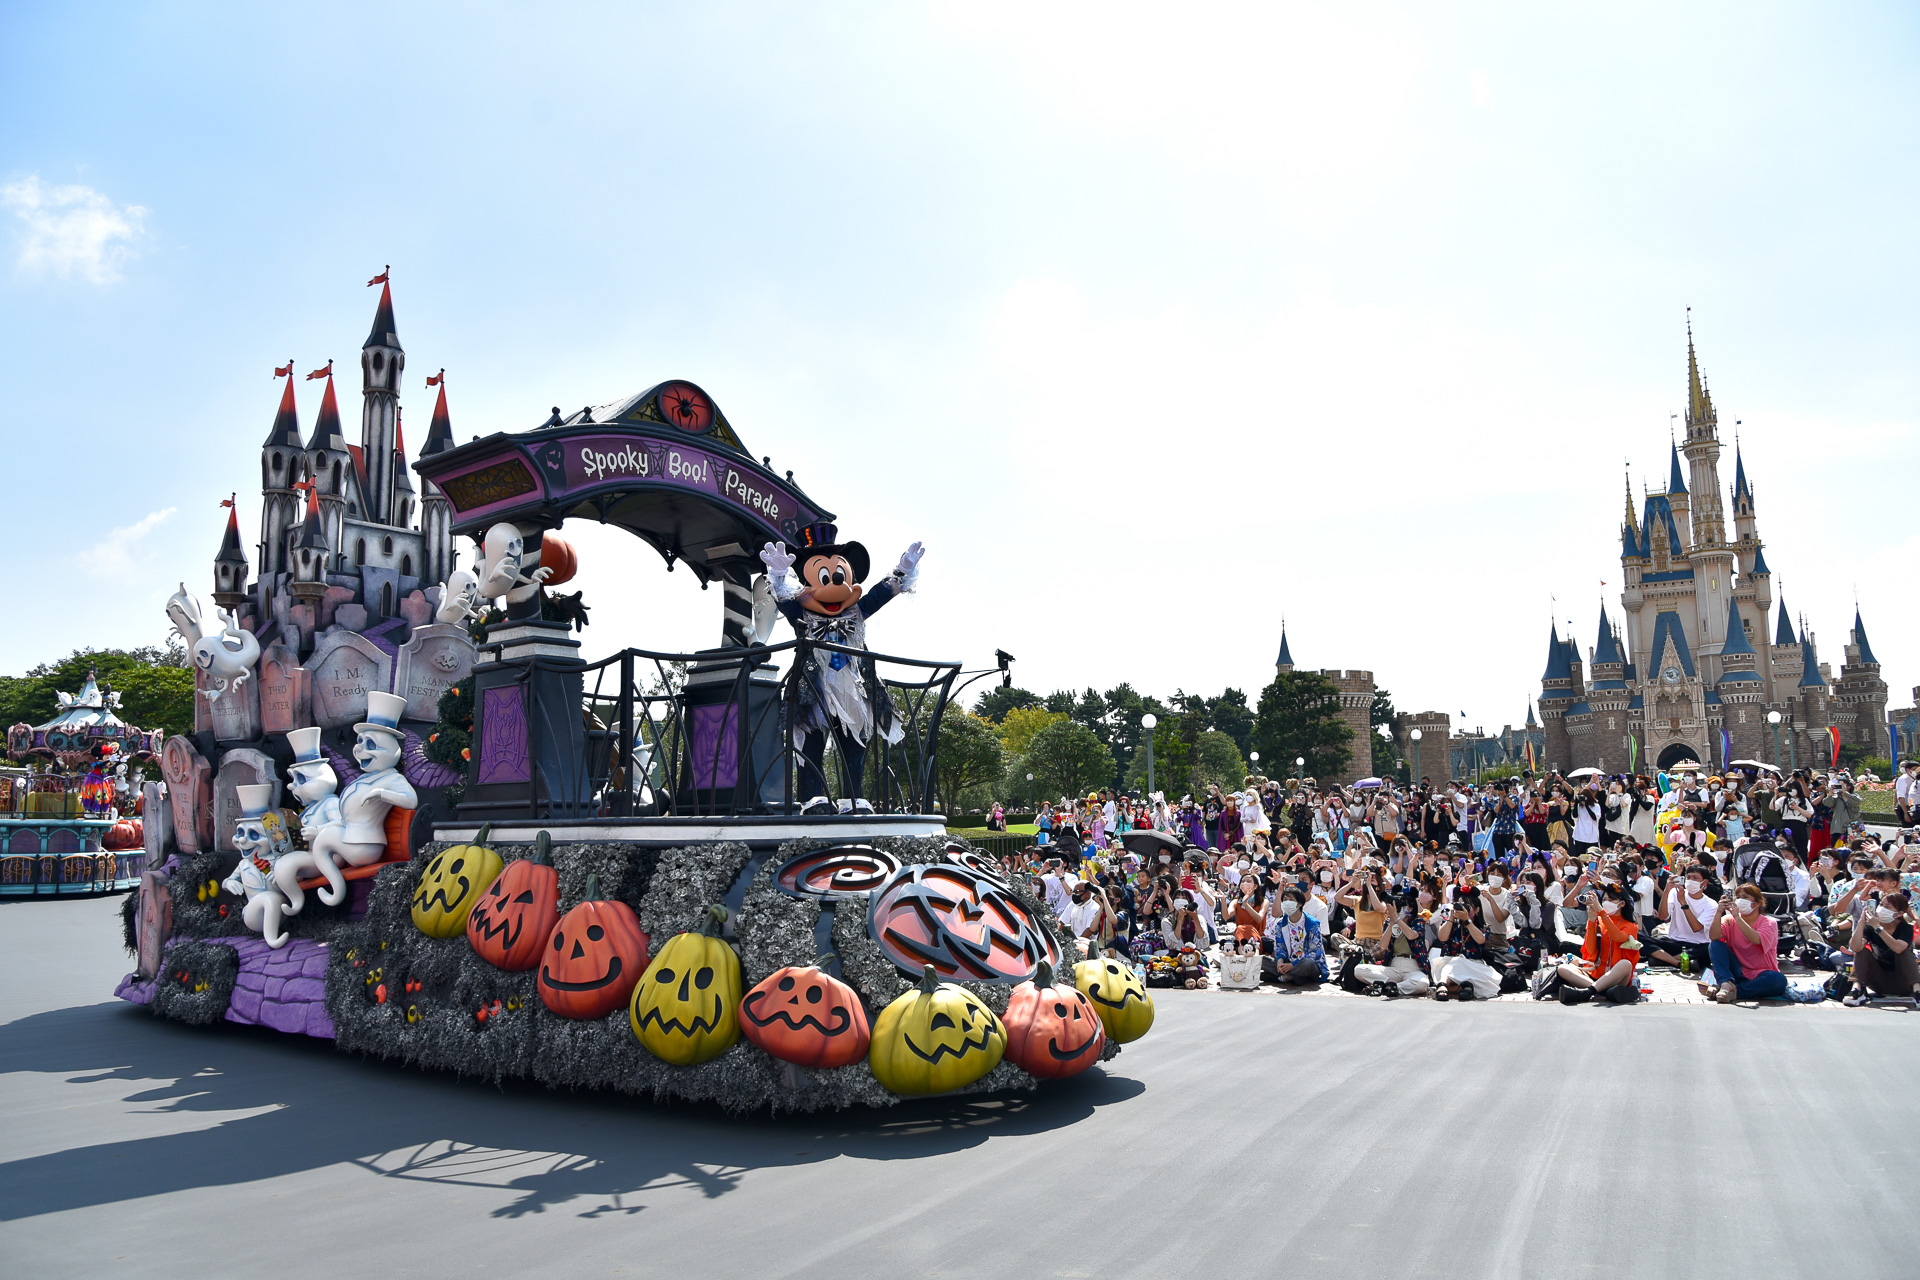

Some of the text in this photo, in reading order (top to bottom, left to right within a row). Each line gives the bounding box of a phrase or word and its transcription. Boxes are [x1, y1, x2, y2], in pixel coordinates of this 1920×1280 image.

[581, 444, 779, 520] Spooky Boo! Parade
[347, 667, 364, 680] M.
[421, 675, 453, 688] MANN
[268, 685, 287, 695] THEO
[332, 684, 368, 698] Ready
[267, 701, 290, 711] LATER
[226, 797, 241, 809] EM
[225, 814, 241, 826] SPO
